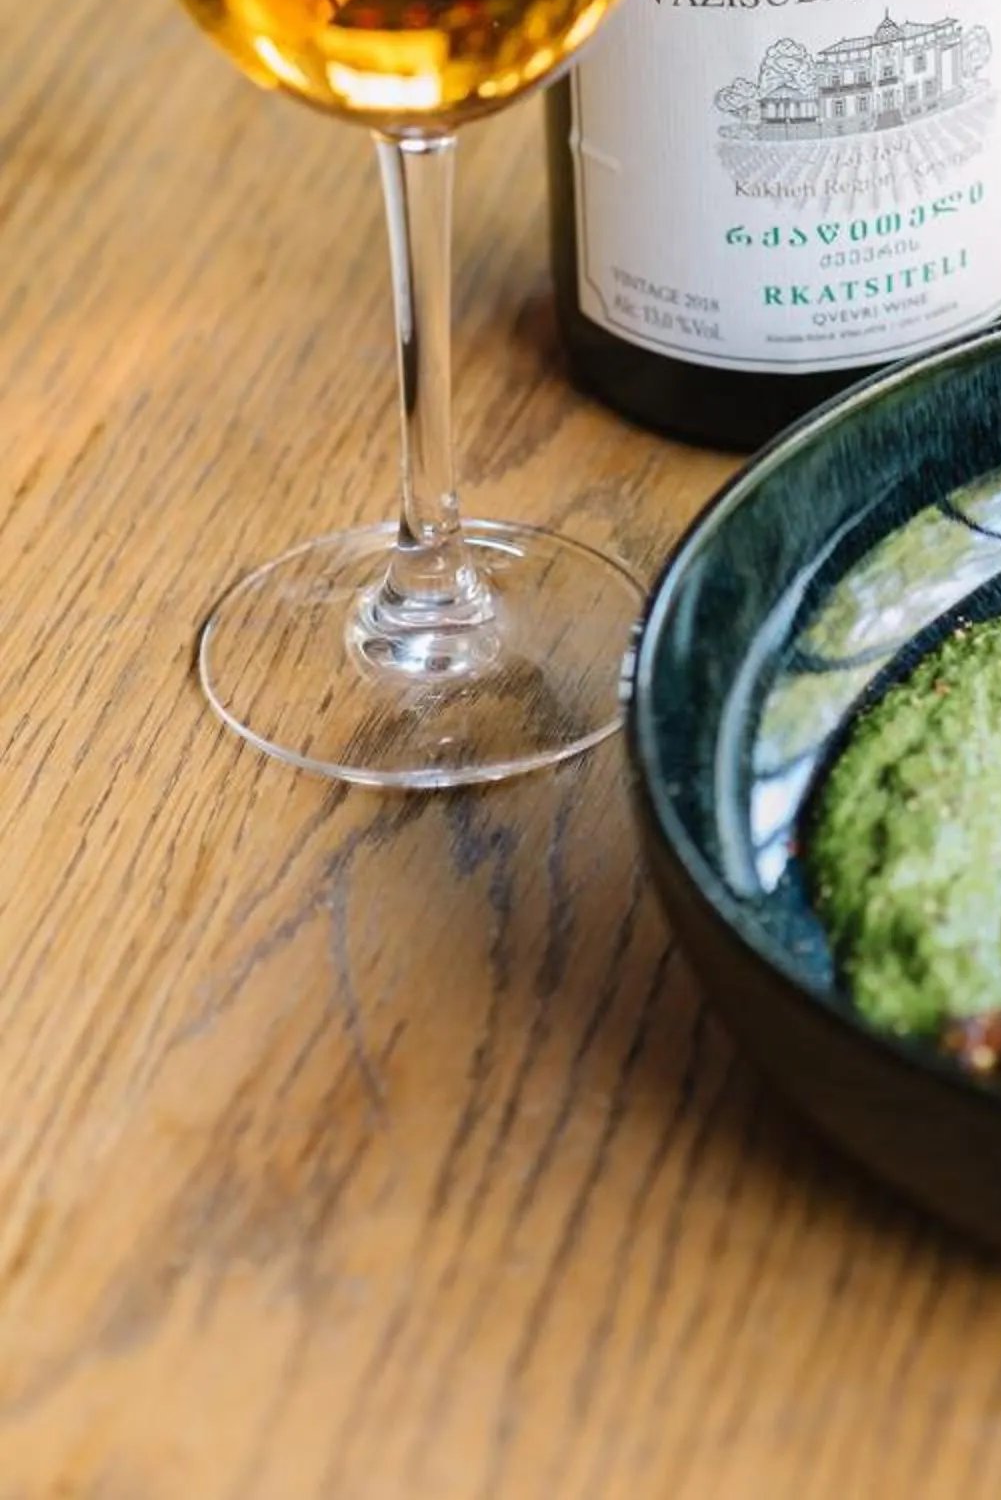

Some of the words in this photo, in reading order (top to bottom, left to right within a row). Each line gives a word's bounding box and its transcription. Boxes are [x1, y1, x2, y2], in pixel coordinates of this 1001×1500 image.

[763, 248, 968, 306] RKATSITELI
[812, 303, 878, 327] QVEVRI
[885, 293, 928, 316] WINE
